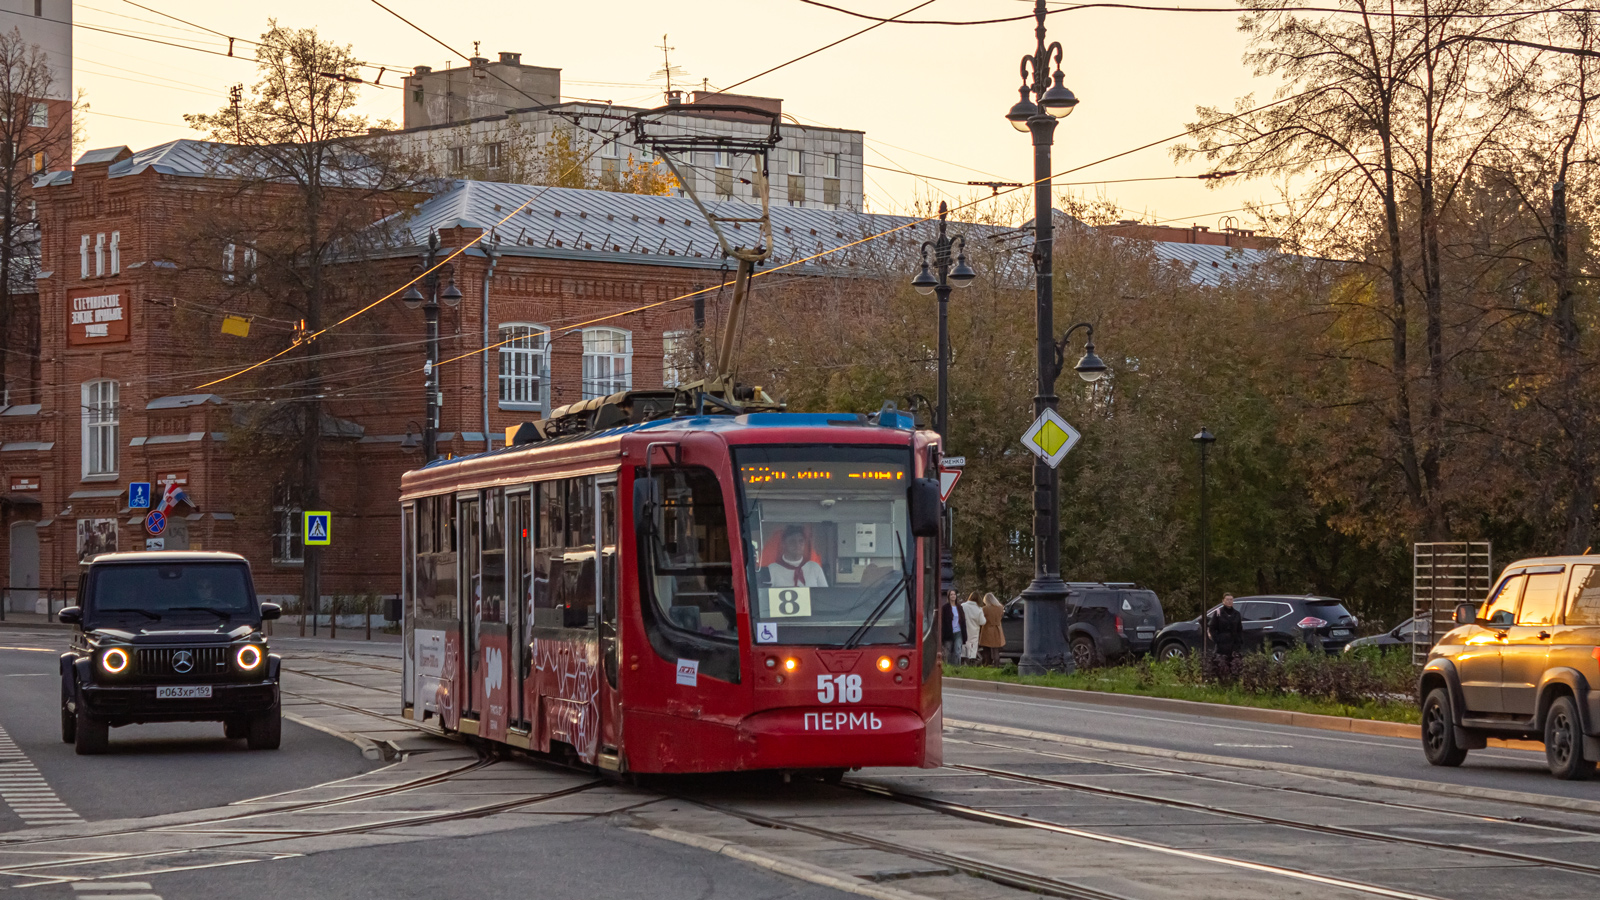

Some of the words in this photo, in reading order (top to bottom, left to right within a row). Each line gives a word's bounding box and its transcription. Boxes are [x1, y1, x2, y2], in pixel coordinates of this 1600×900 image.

[778, 589, 800, 615] 8
[196, 686, 209, 694] 159
[817, 674, 863, 703] 518
[804, 712, 882, 730] ПЕРМЬ
